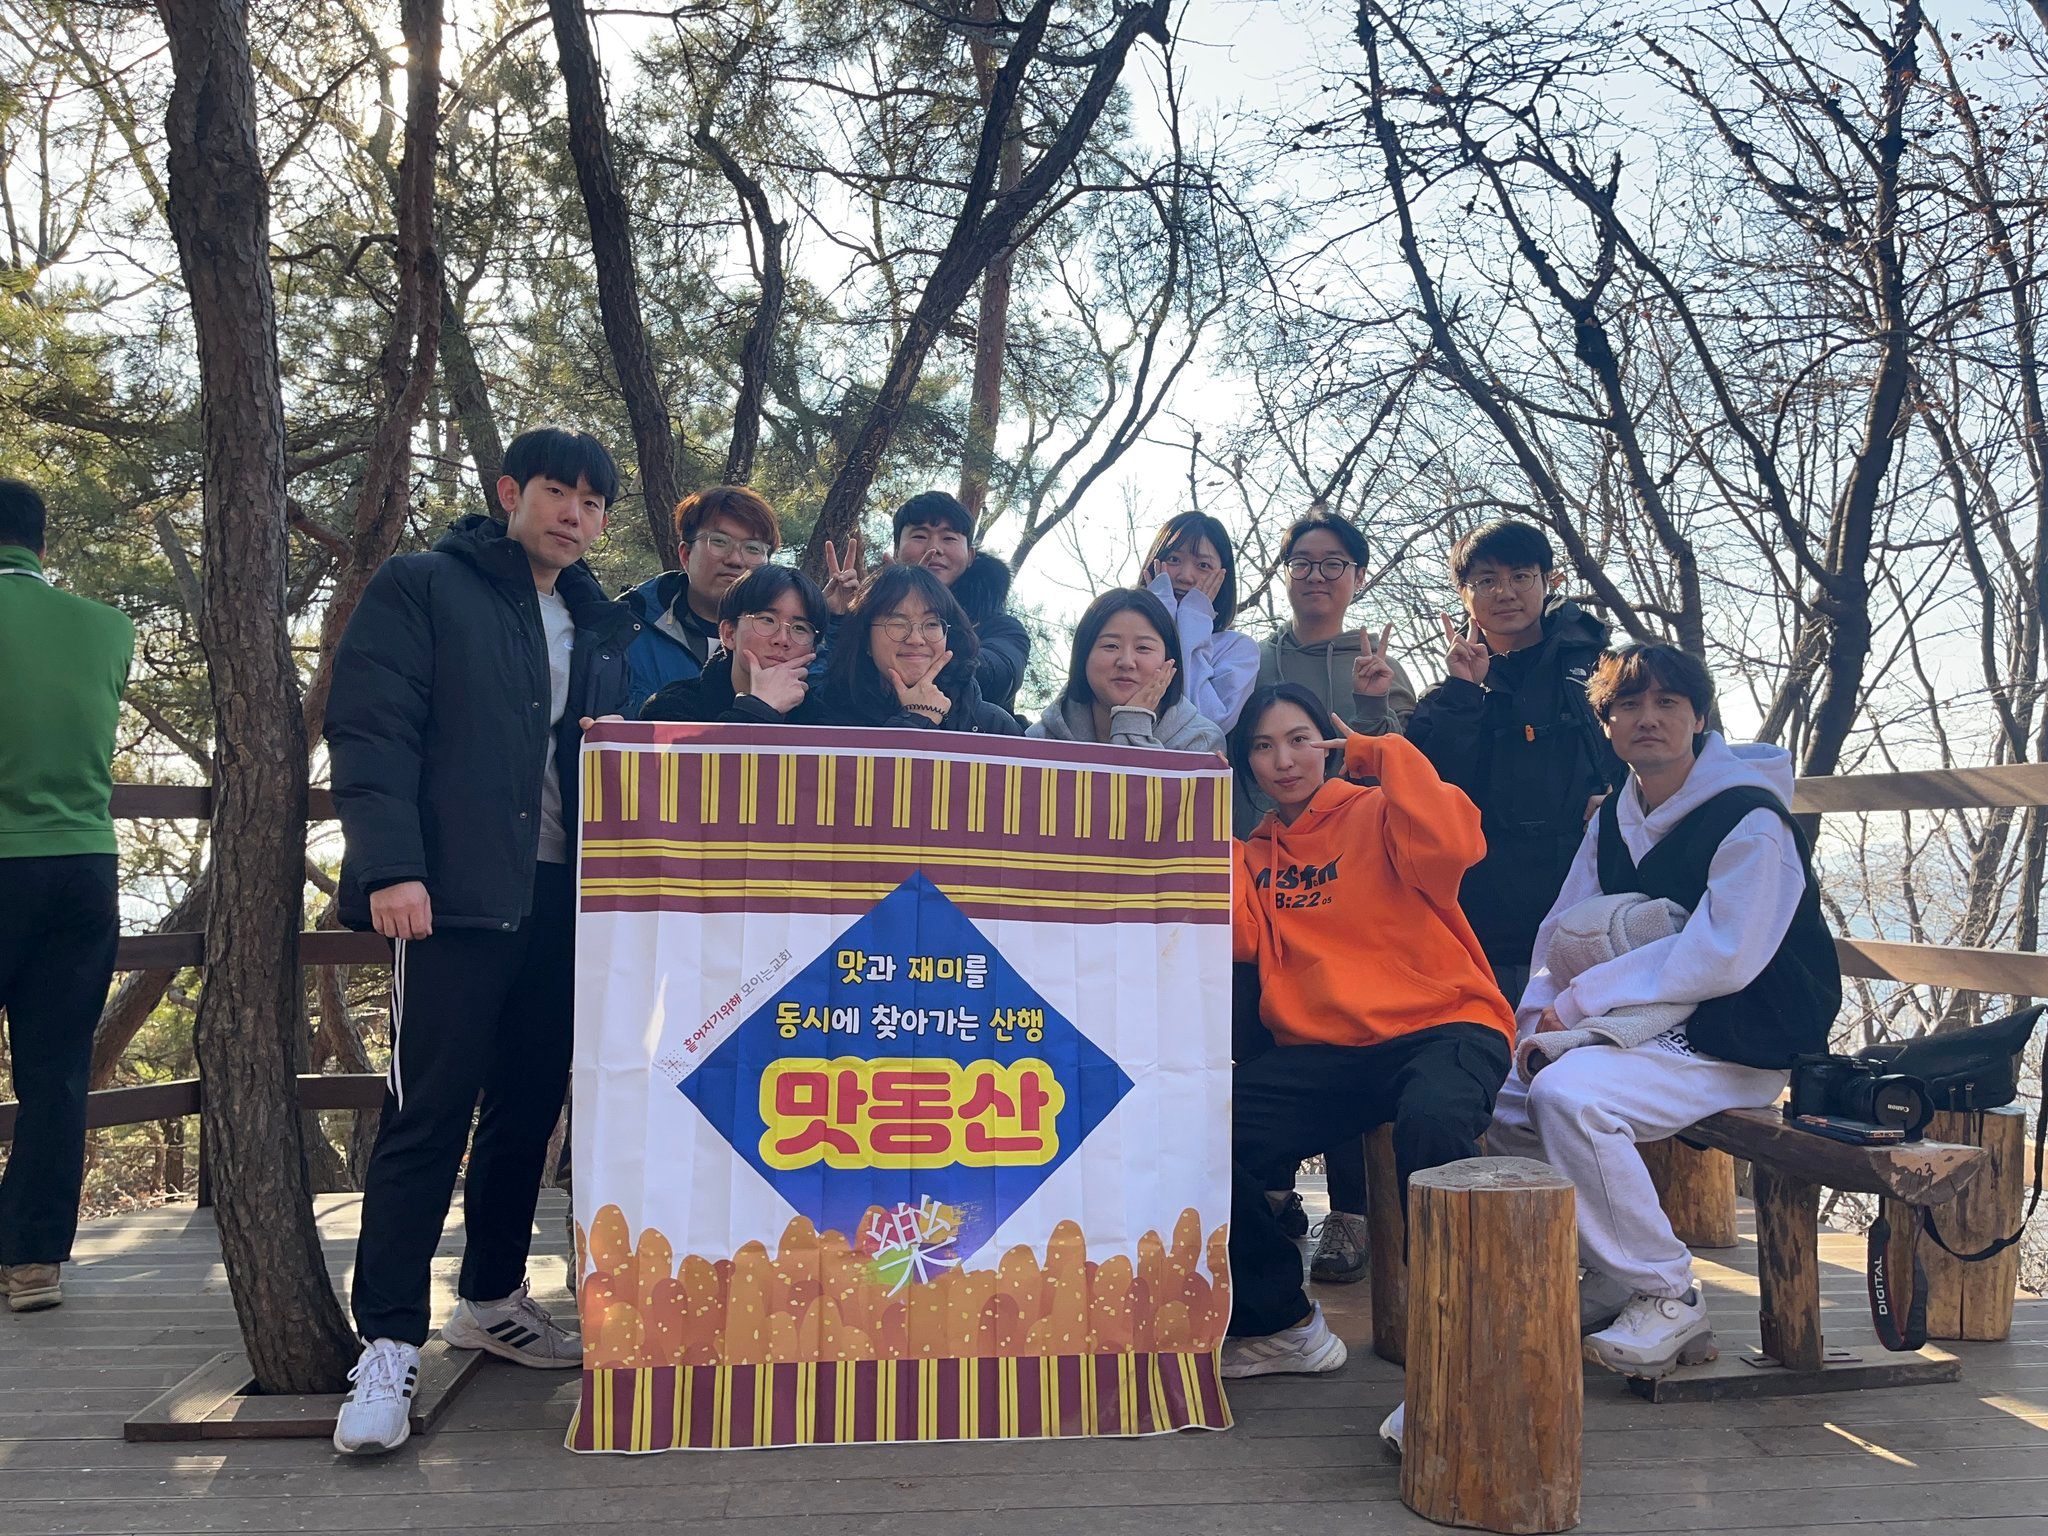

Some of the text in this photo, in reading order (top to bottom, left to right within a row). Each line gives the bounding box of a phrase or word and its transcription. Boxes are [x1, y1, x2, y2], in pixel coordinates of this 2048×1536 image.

[837, 950, 988, 989] 맛과 재미를
[683, 993, 742, 1053] 흩어지기위해
[741, 949, 792, 997] 모이는교회
[775, 1002, 1044, 1042] 동시에 찾아가는 산행
[770, 1066, 1055, 1160] 맛동산
[1887, 1103, 1910, 1113] Canon
[866, 1194, 962, 1298] 樂
[1874, 1255, 1888, 1315] DIGITAL
